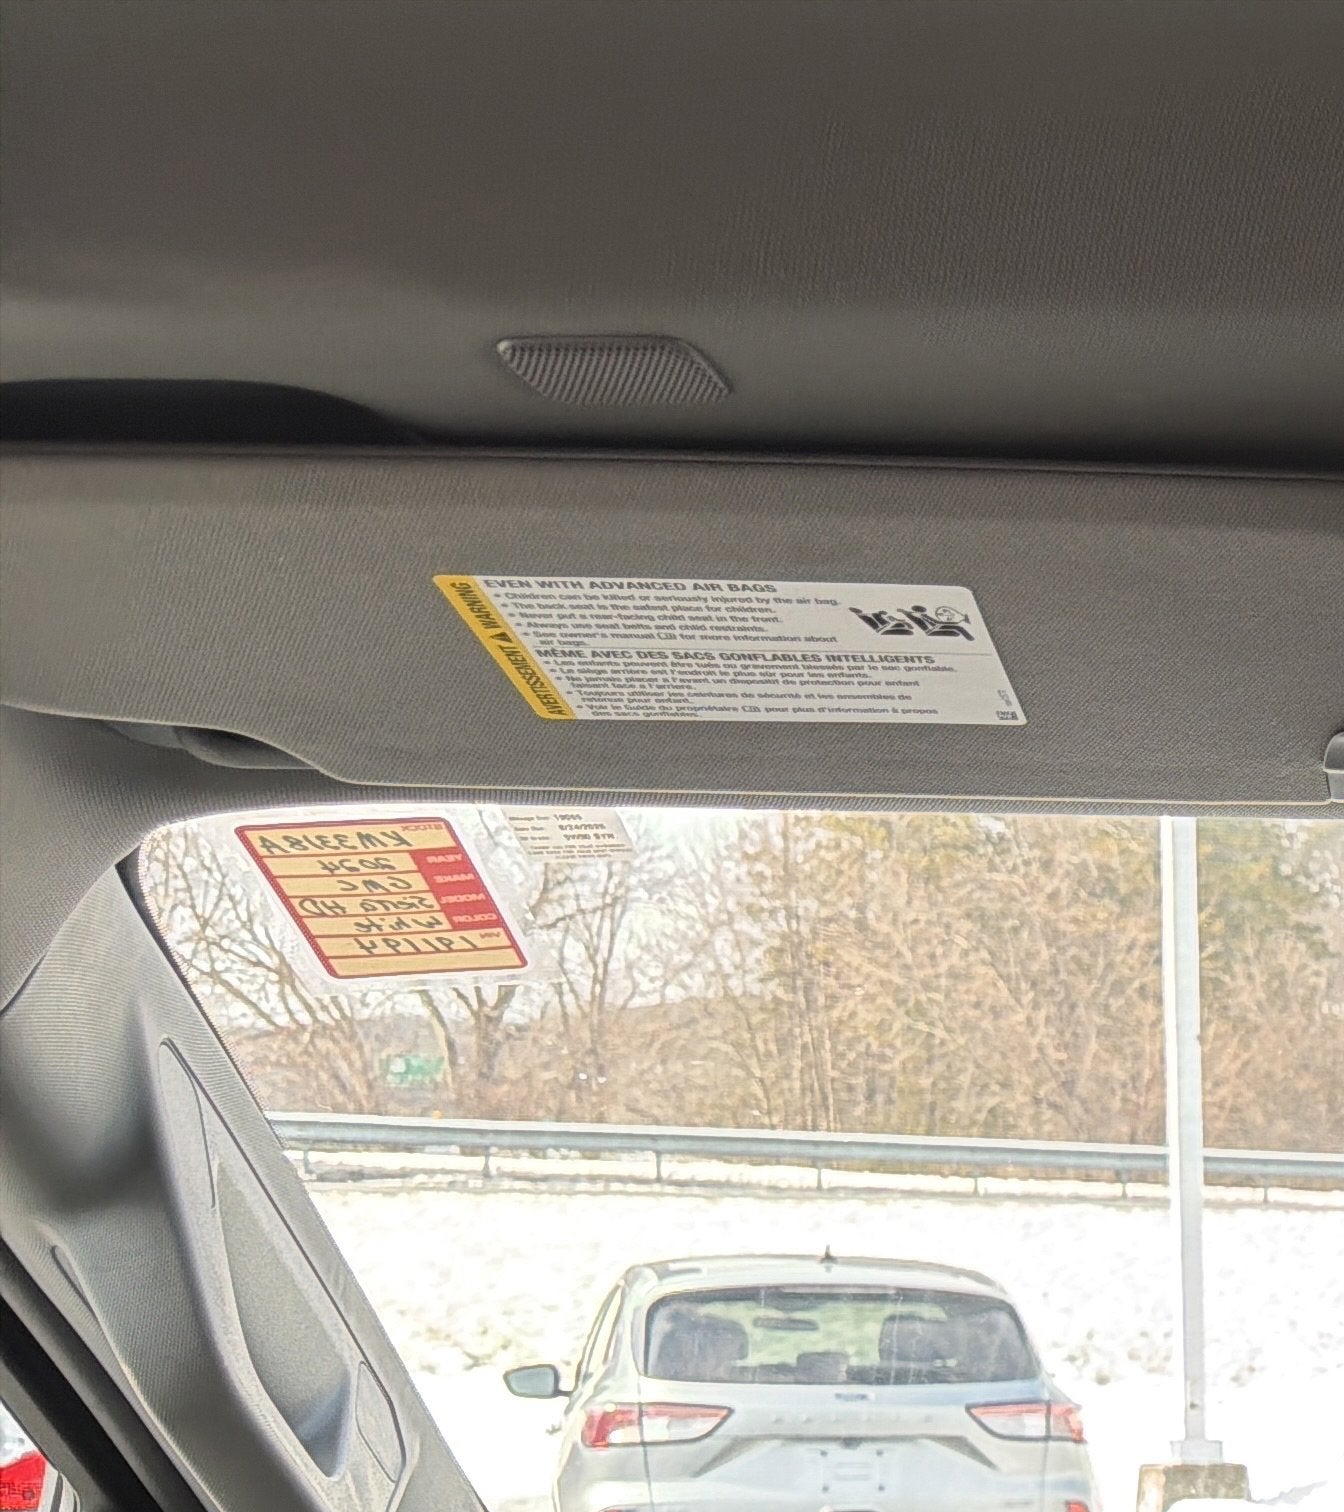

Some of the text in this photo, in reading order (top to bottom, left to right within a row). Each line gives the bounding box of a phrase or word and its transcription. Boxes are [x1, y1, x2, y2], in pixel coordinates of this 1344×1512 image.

[481, 578, 778, 593] EVEN WITH ADVANCED AIR BAGS
[450, 582, 500, 629] WARNING
[533, 646, 936, 664] MÊME AVEC DES SACS GONFLABLES INTELLIGENTS
[498, 644, 568, 715] AVERTISSEMENT
